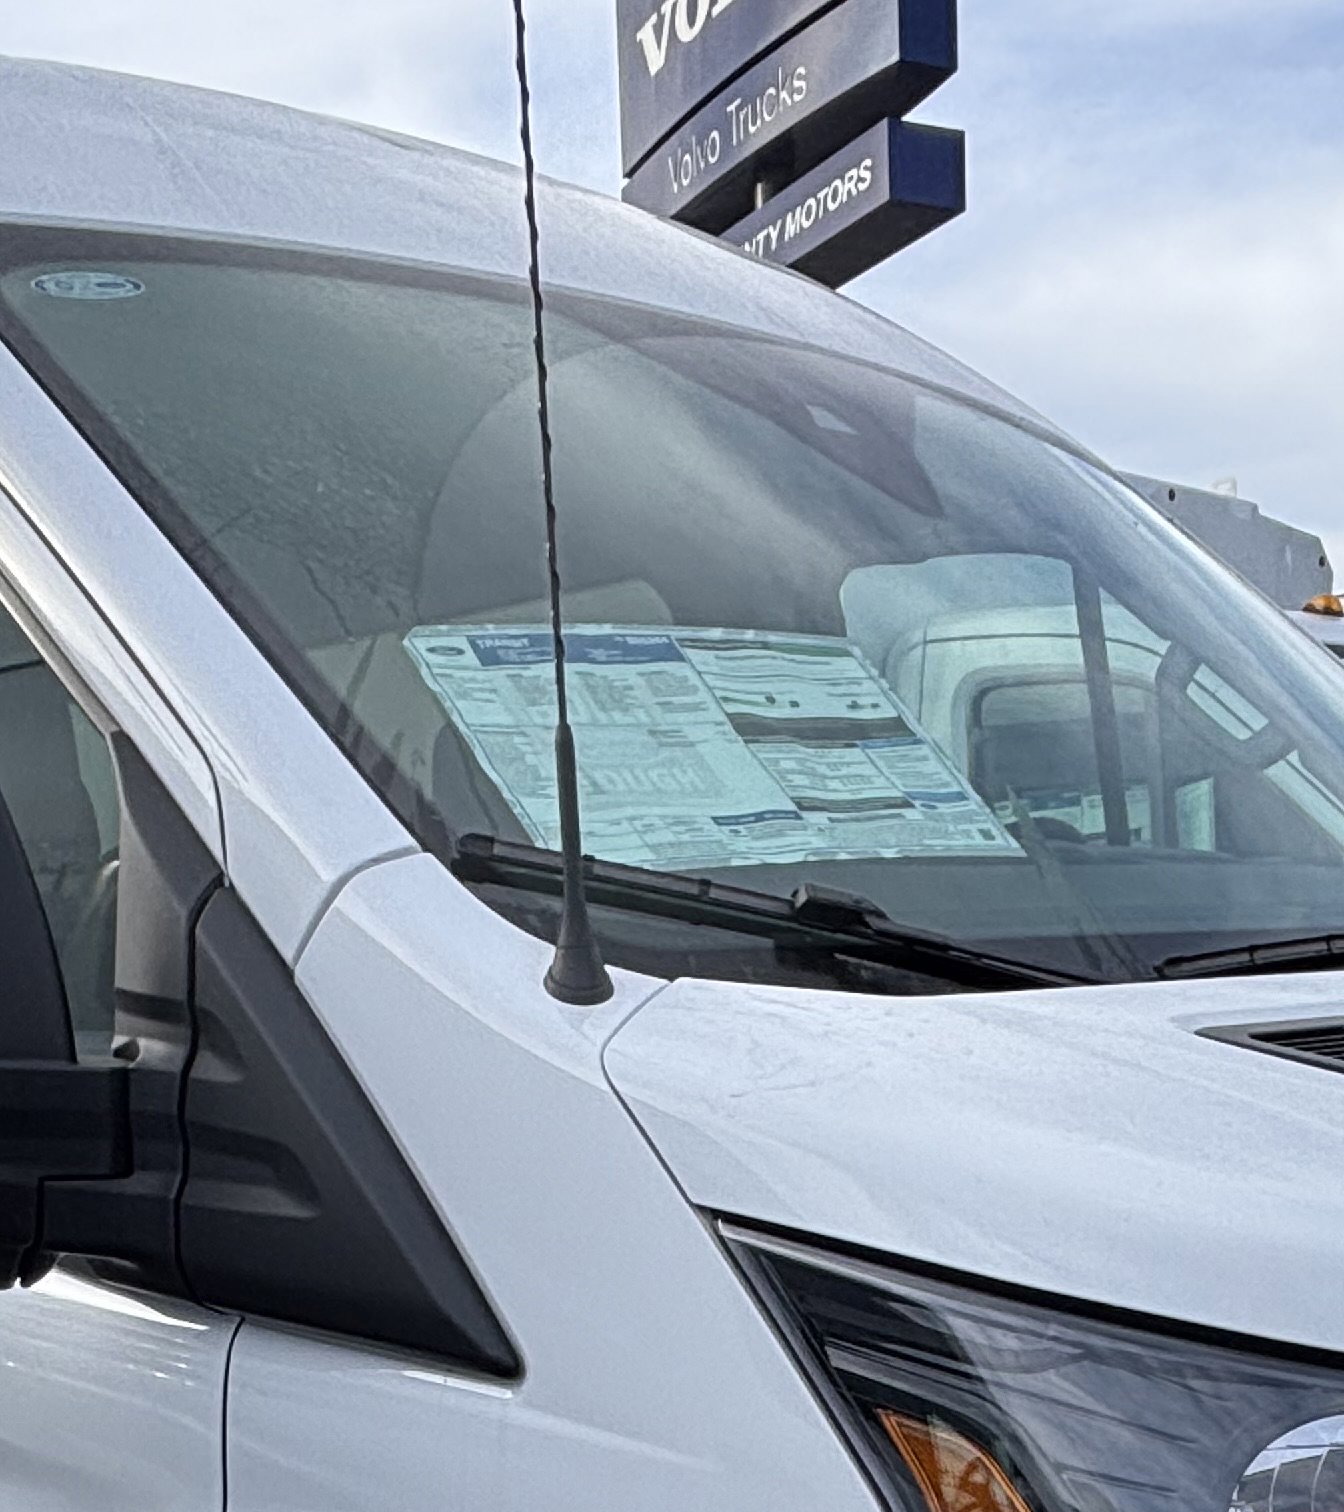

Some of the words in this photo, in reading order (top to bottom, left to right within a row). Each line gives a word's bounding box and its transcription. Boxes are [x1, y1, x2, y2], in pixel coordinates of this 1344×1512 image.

[668, 129, 720, 194] Volvo
[726, 66, 807, 147] Trucks
[741, 219, 782, 258] NTY
[784, 158, 872, 242] MOTORS
